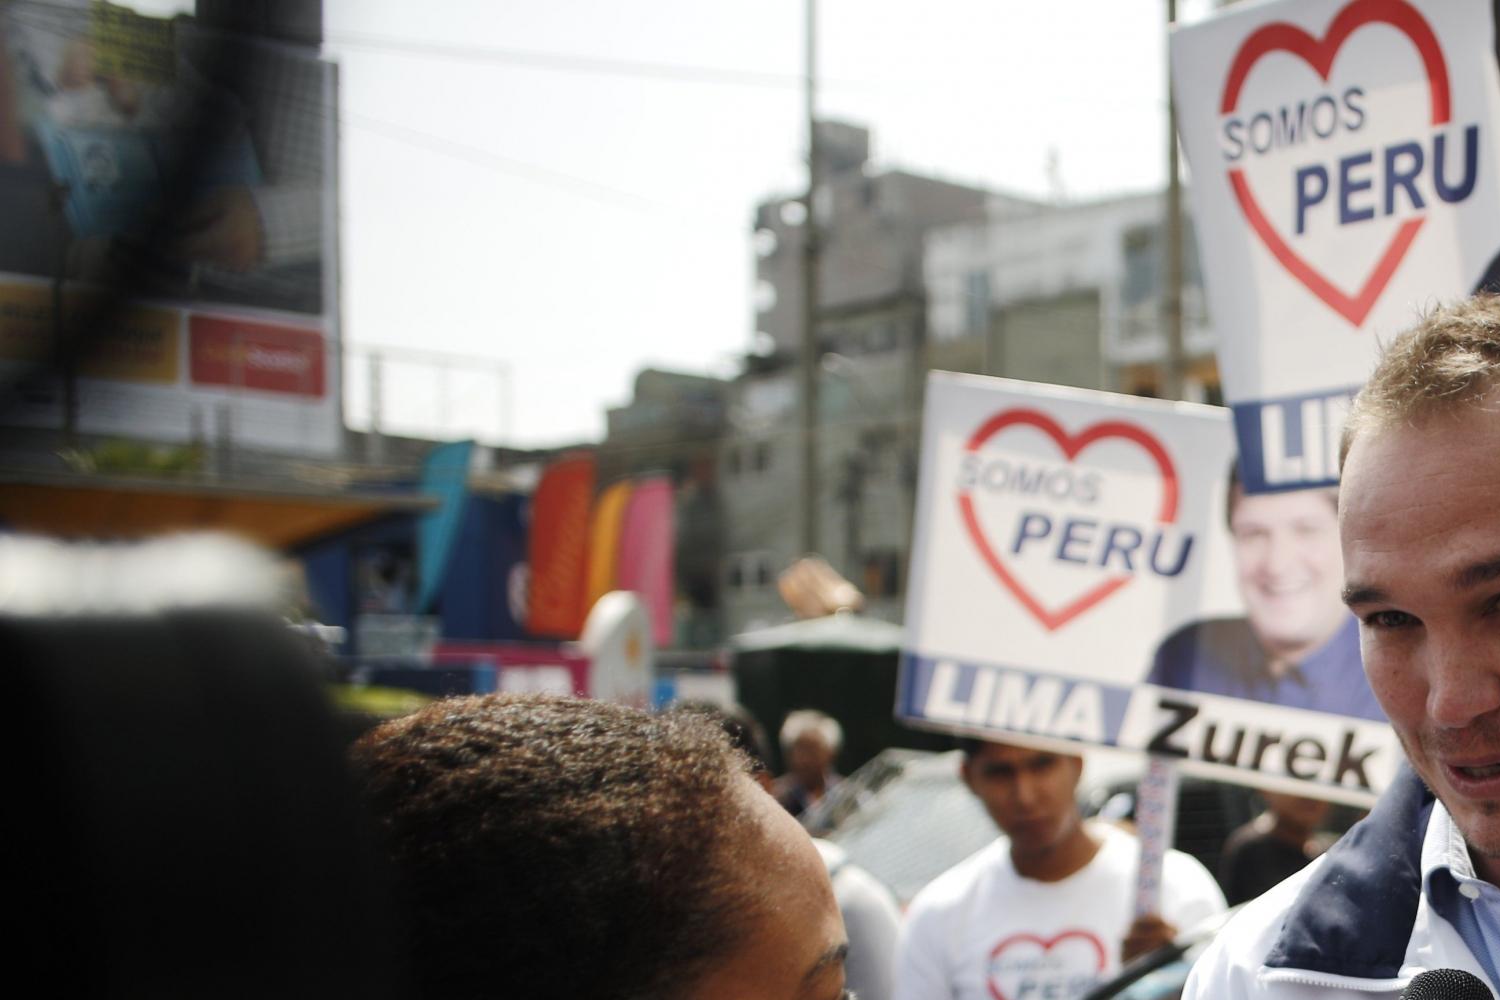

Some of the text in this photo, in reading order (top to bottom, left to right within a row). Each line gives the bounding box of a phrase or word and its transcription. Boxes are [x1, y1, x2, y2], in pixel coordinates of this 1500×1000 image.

[1222, 85, 1365, 163] SOMOS
[1294, 124, 1480, 235] PERU
[956, 455, 1106, 504] SOMOS
[1260, 395, 1350, 485] LI
[1011, 512, 1195, 579] PERU
[925, 662, 1381, 793] LIMA Zurek
